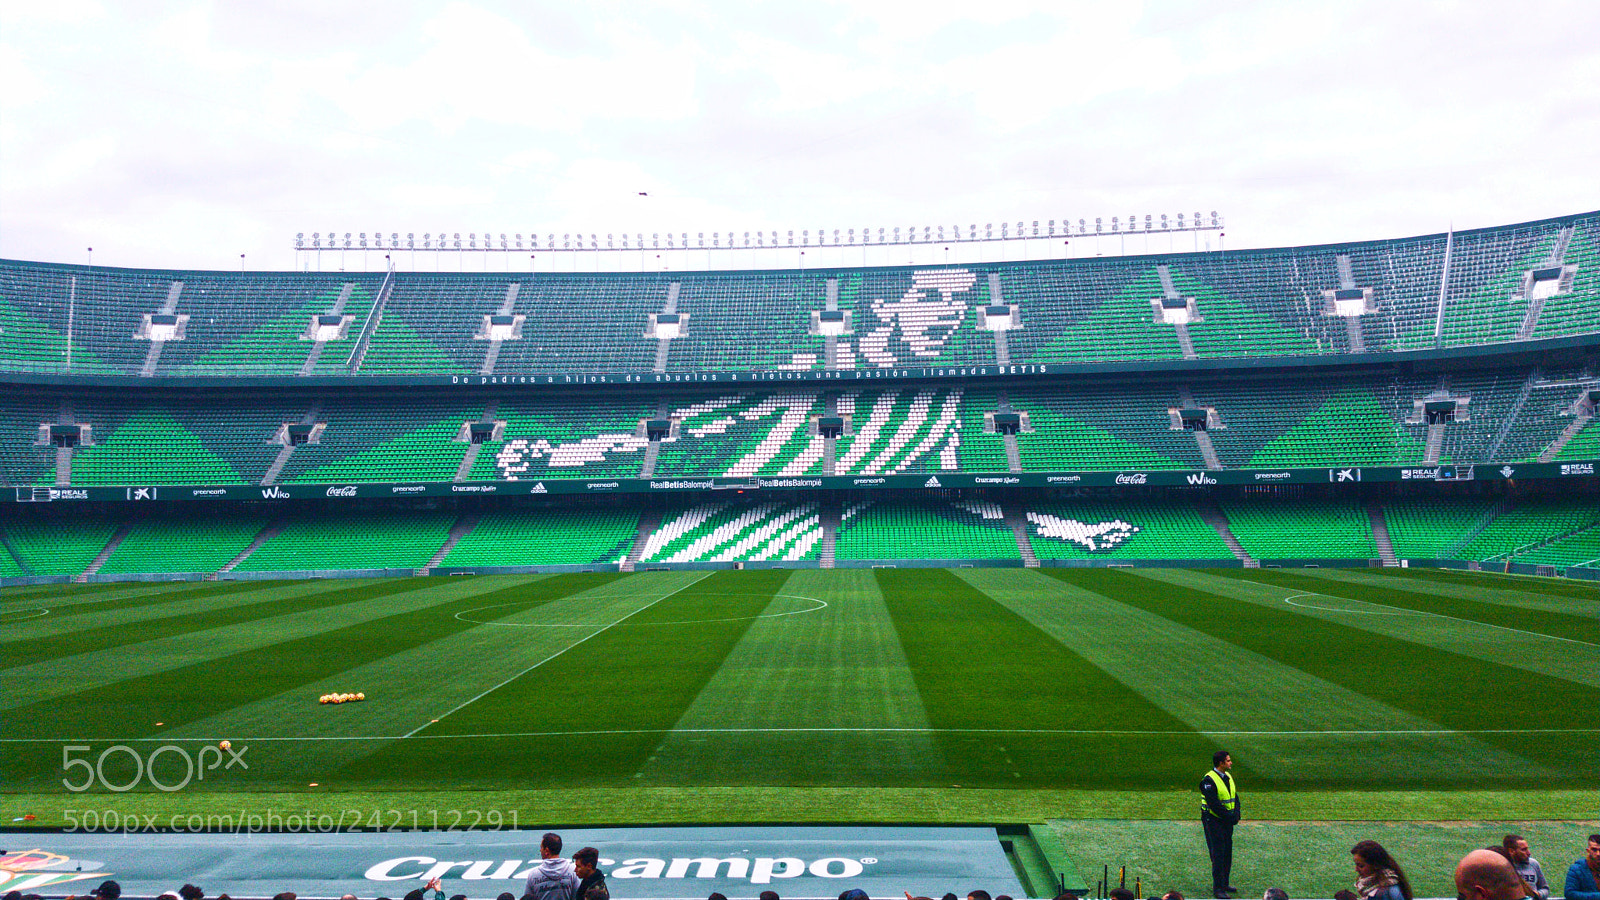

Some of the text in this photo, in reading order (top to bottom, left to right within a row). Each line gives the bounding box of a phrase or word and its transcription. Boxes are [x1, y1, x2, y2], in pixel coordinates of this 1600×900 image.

[452, 375, 469, 384] De
[482, 375, 536, 385] padres
[548, 375, 553, 383] a
[626, 375, 641, 383] de
[656, 373, 717, 382] abuelos
[856, 370, 908, 379] pasión
[923, 368, 986, 376] llamada
[999, 365, 1047, 374] BETIS
[1047, 475, 1081, 483] greenearth
[1255, 472, 1291, 480] greenearth
[192, 488, 227, 496] greenearth
